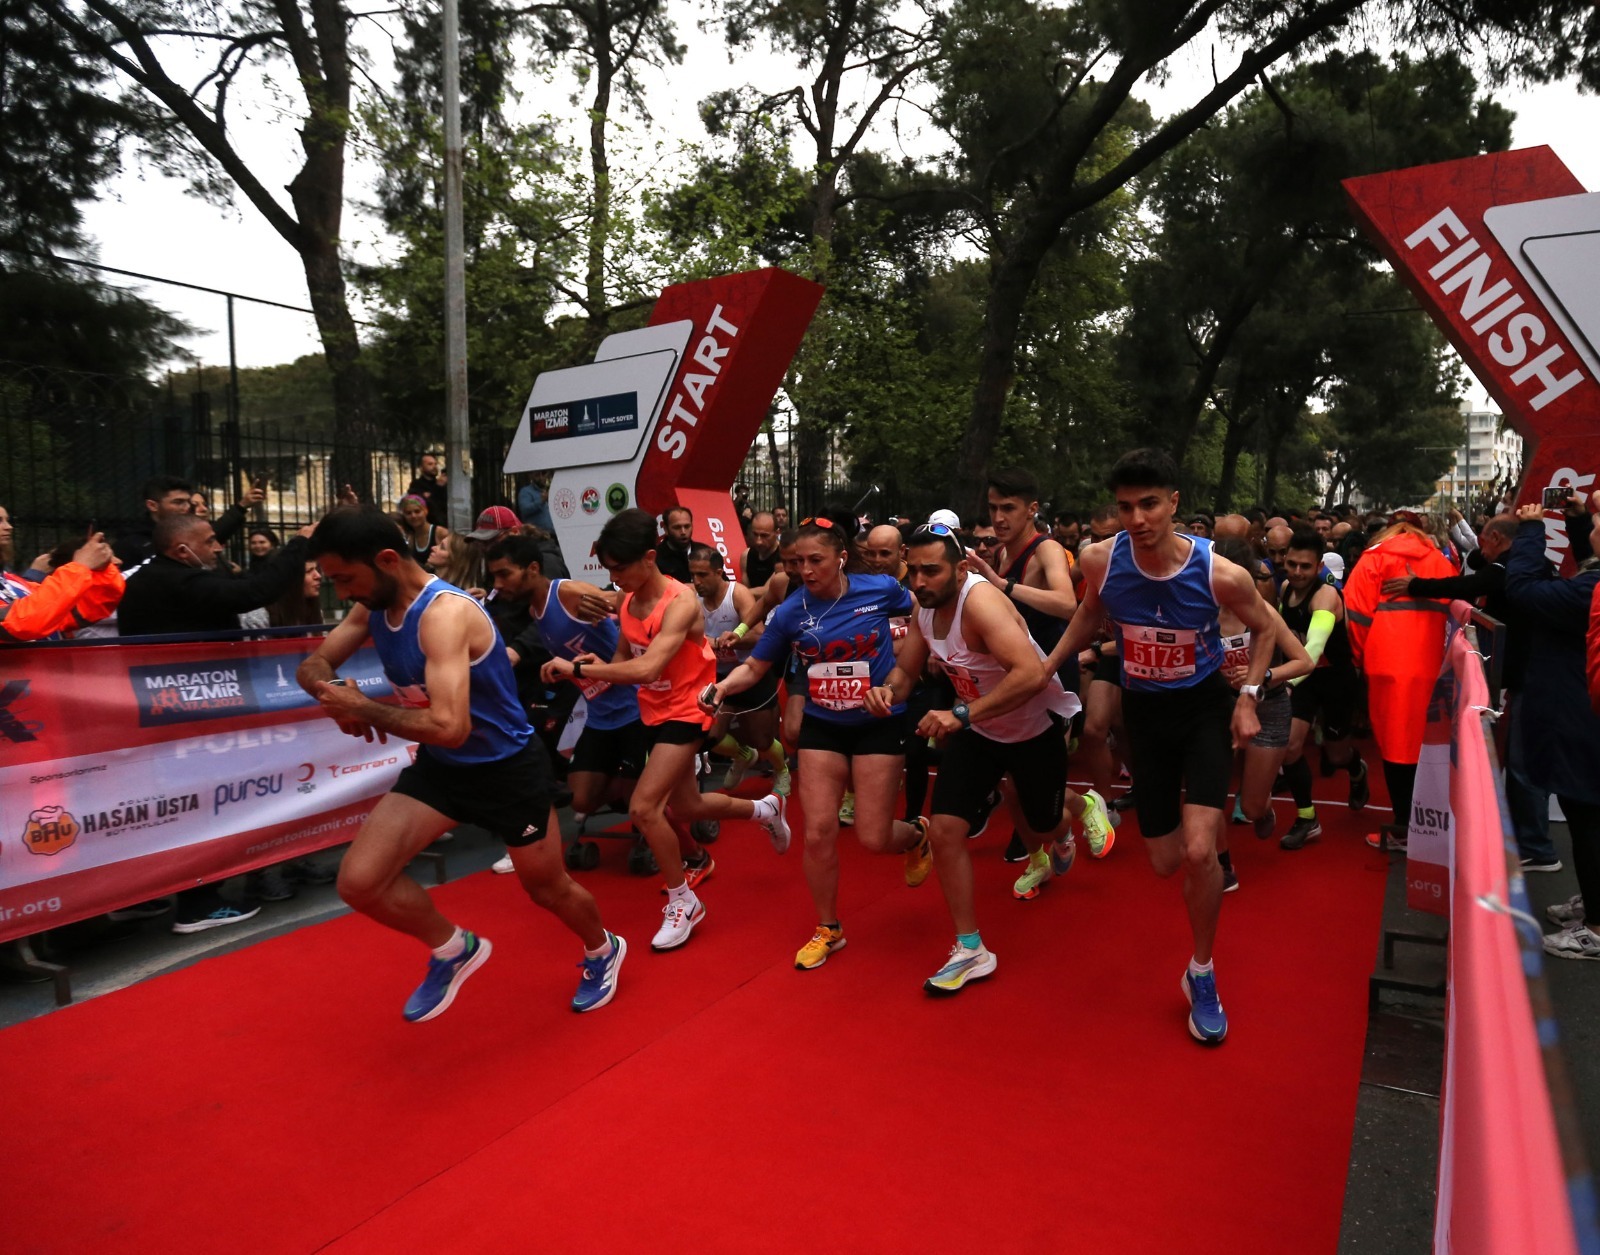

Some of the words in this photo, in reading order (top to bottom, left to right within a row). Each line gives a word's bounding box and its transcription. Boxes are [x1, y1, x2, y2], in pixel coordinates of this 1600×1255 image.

[1404, 206, 1585, 412] FINISH
[658, 303, 738, 459] START
[534, 408, 568, 421] MARATON
[1133, 643, 1185, 667] 5173
[145, 669, 238, 690] MARATON
[818, 679, 862, 699] 4432
[341, 756, 398, 775] carraro
[82, 803, 149, 834] HASAN
[156, 793, 199, 818] USTA
[31, 822, 71, 844] BHU
